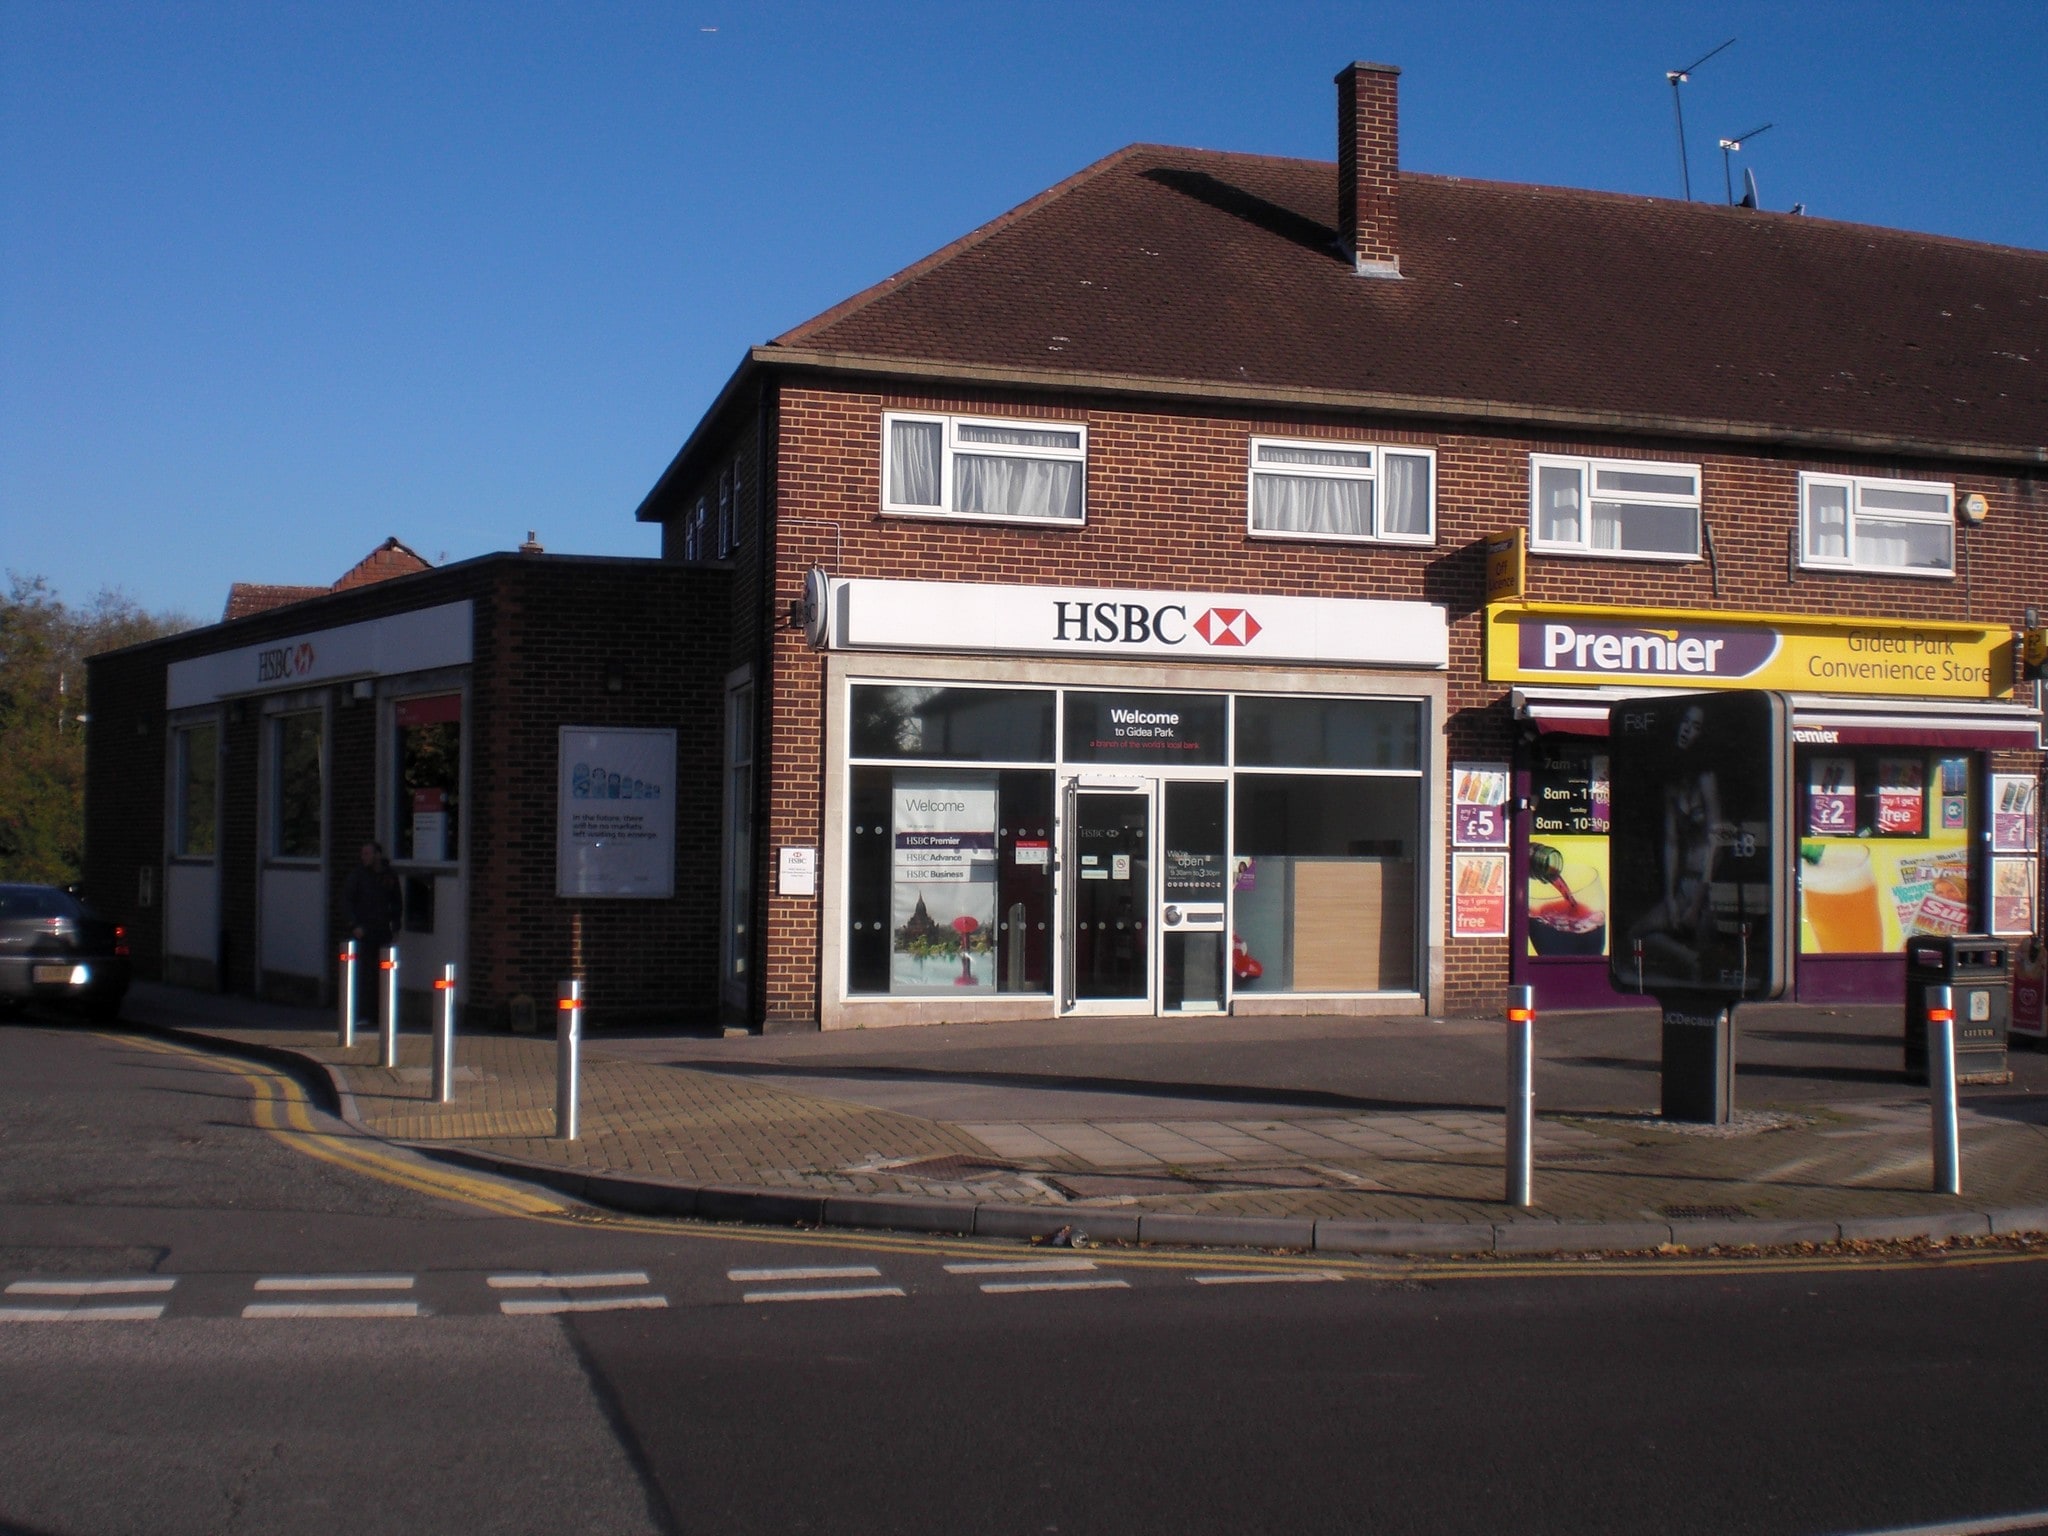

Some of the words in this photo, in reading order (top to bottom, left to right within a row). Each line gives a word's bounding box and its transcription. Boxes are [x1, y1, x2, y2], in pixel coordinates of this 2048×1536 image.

[1053, 601, 1187, 645] HSBC
[1544, 624, 1724, 672] Premier
[1848, 631, 1907, 654] Gidea
[1913, 633, 1955, 655] Park
[258, 647, 293, 682] HSBC
[1808, 656, 1936, 681] Convenience
[1942, 660, 1991, 683] Store
[1110, 709, 1179, 725] Welcome
[1624, 712, 1655, 732] F&F
[1115, 727, 1125, 736] to
[1126, 727, 1153, 737] Gidea
[1154, 727, 1174, 738] Park
[1793, 727, 1839, 744] remier
[1095, 740, 1119, 748] branch
[1120, 740, 1128, 748] of
[1129, 740, 1140, 748] the
[1166, 741, 1182, 749] local
[1183, 741, 1200, 749] bank
[1543, 787, 1571, 800] 8am
[1880, 796, 1894, 806] buy
[906, 799, 965, 812] Welcome
[1821, 800, 1845, 824] £2
[1881, 806, 1911, 823] free
[1467, 811, 1494, 836] £5
[1535, 817, 1563, 830] 8am
[1573, 817, 1610, 832] 10:30p
[906, 836, 930, 846] HSBC
[930, 836, 960, 846] Premier
[1081, 829, 1103, 838] HSBC
[906, 854, 930, 862] HSBC
[930, 854, 962, 862] Advance
[1178, 858, 1204, 868] open
[906, 870, 930, 878] HSBC
[930, 870, 964, 878] Business
[1457, 913, 1486, 928] free
[1664, 1012, 1715, 1027] JCDecaux
[1963, 1029, 1994, 1037] LITTER
